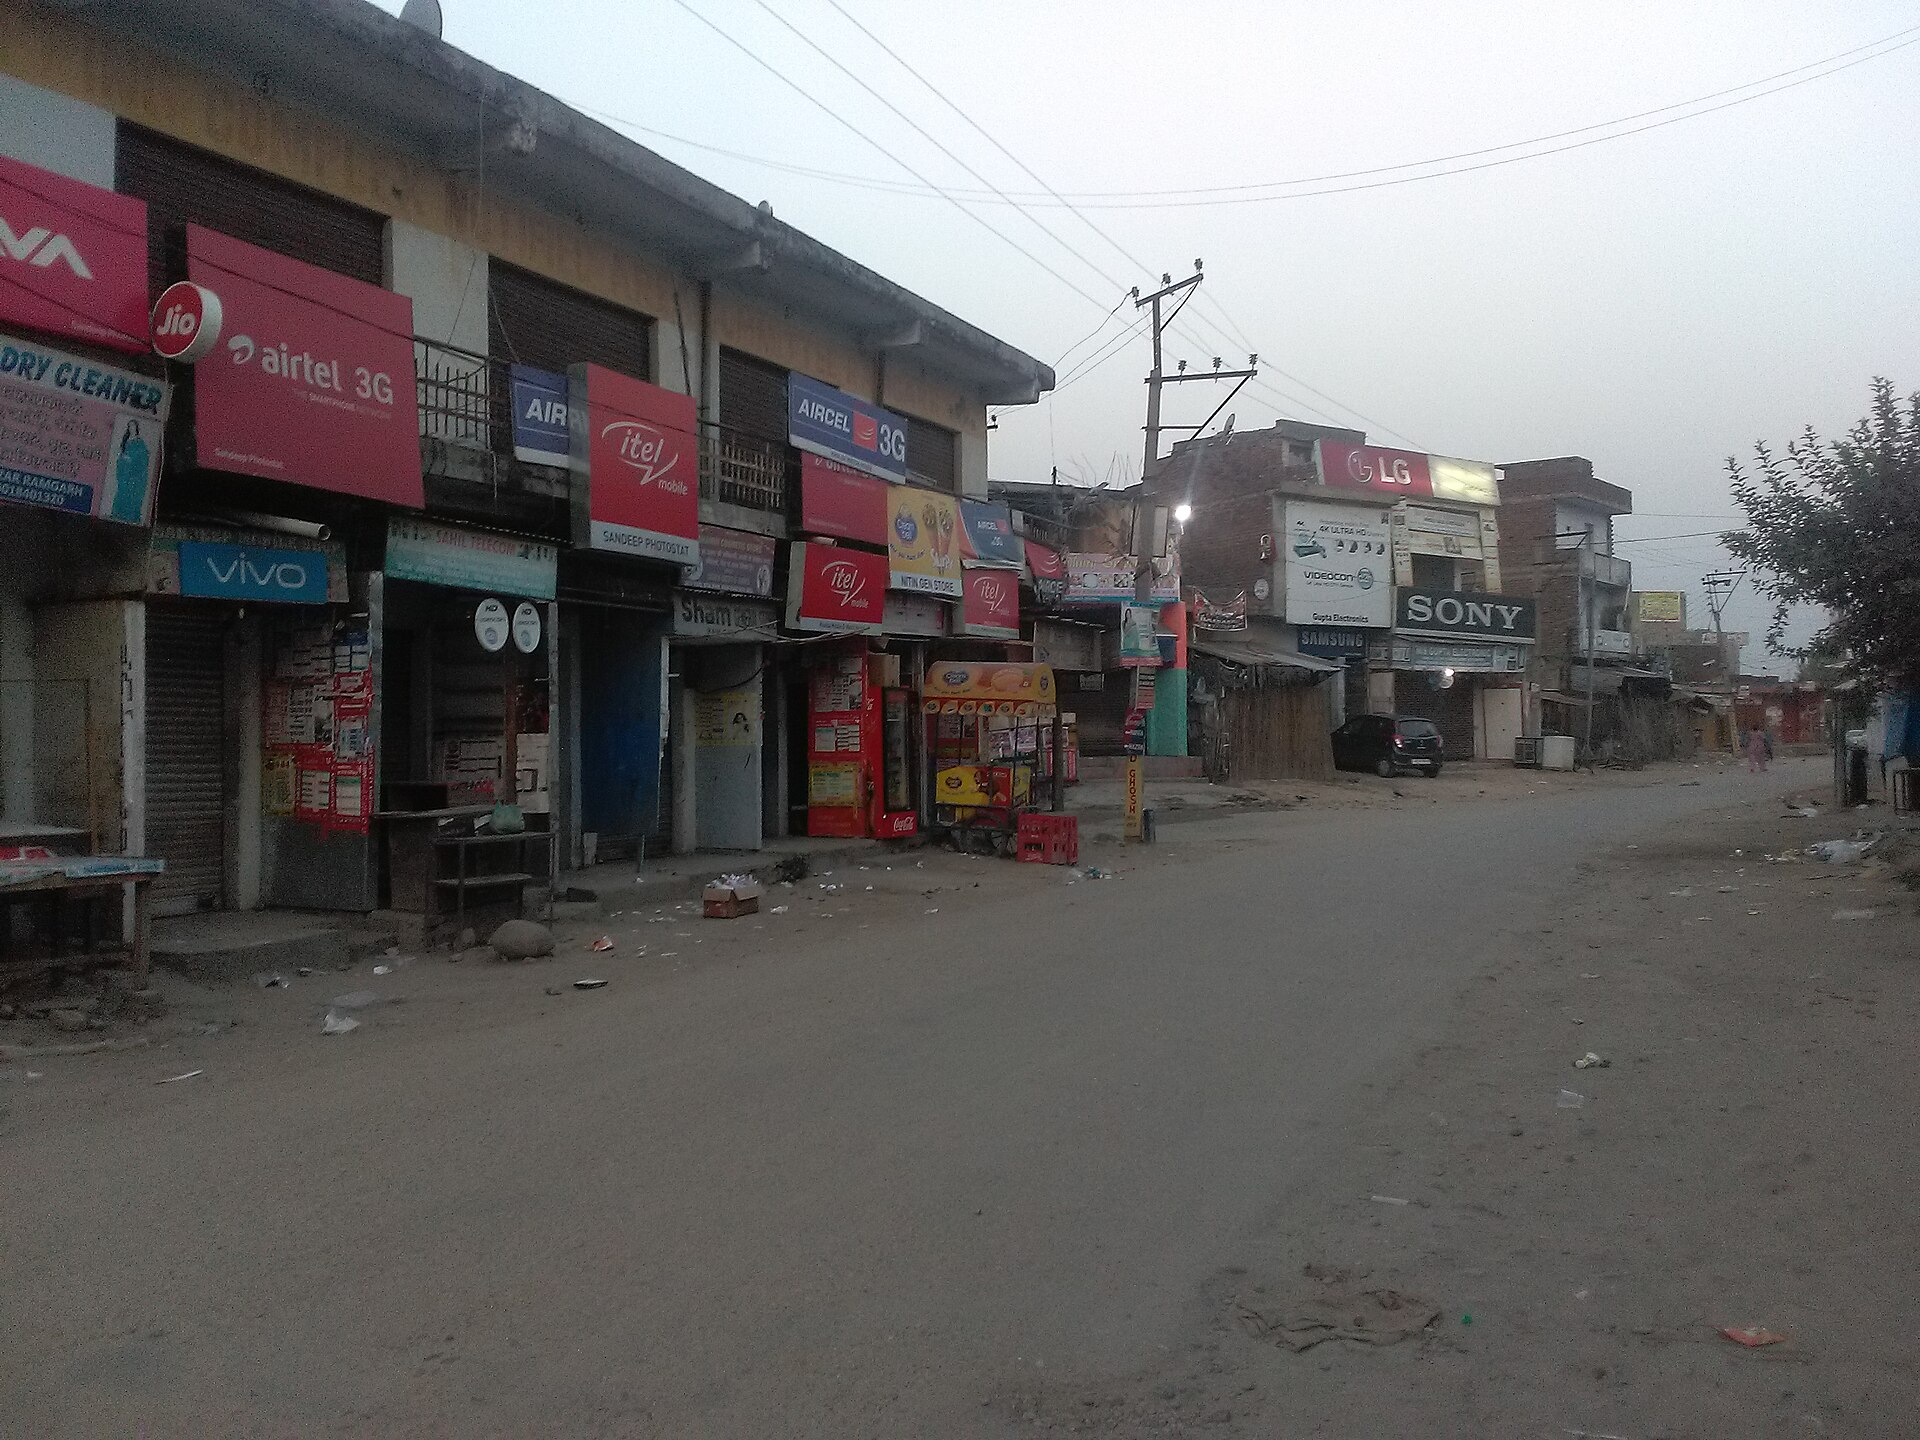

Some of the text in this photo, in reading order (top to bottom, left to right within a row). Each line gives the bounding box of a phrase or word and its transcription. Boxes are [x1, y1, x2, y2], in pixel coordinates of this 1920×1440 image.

[157, 303, 196, 337] Jio
[1, 346, 53, 381] DRY
[261, 342, 394, 405] airtel 3G
[798, 398, 907, 463] AIRCEL 3G
[620, 427, 665, 464] itel
[1378, 456, 1413, 485] LG
[657, 477, 689, 497] mobile
[602, 530, 690, 557] SANDEEP PHOTOSTAT
[206, 551, 307, 589] vivo
[830, 567, 858, 589] itel
[1303, 570, 1355, 582] VIDEOCON
[980, 580, 1000, 600] itel
[1312, 612, 1369, 624] Gupta Electronics
[1406, 594, 1524, 630] SONY
[1301, 630, 1364, 648] SAMSUNG
